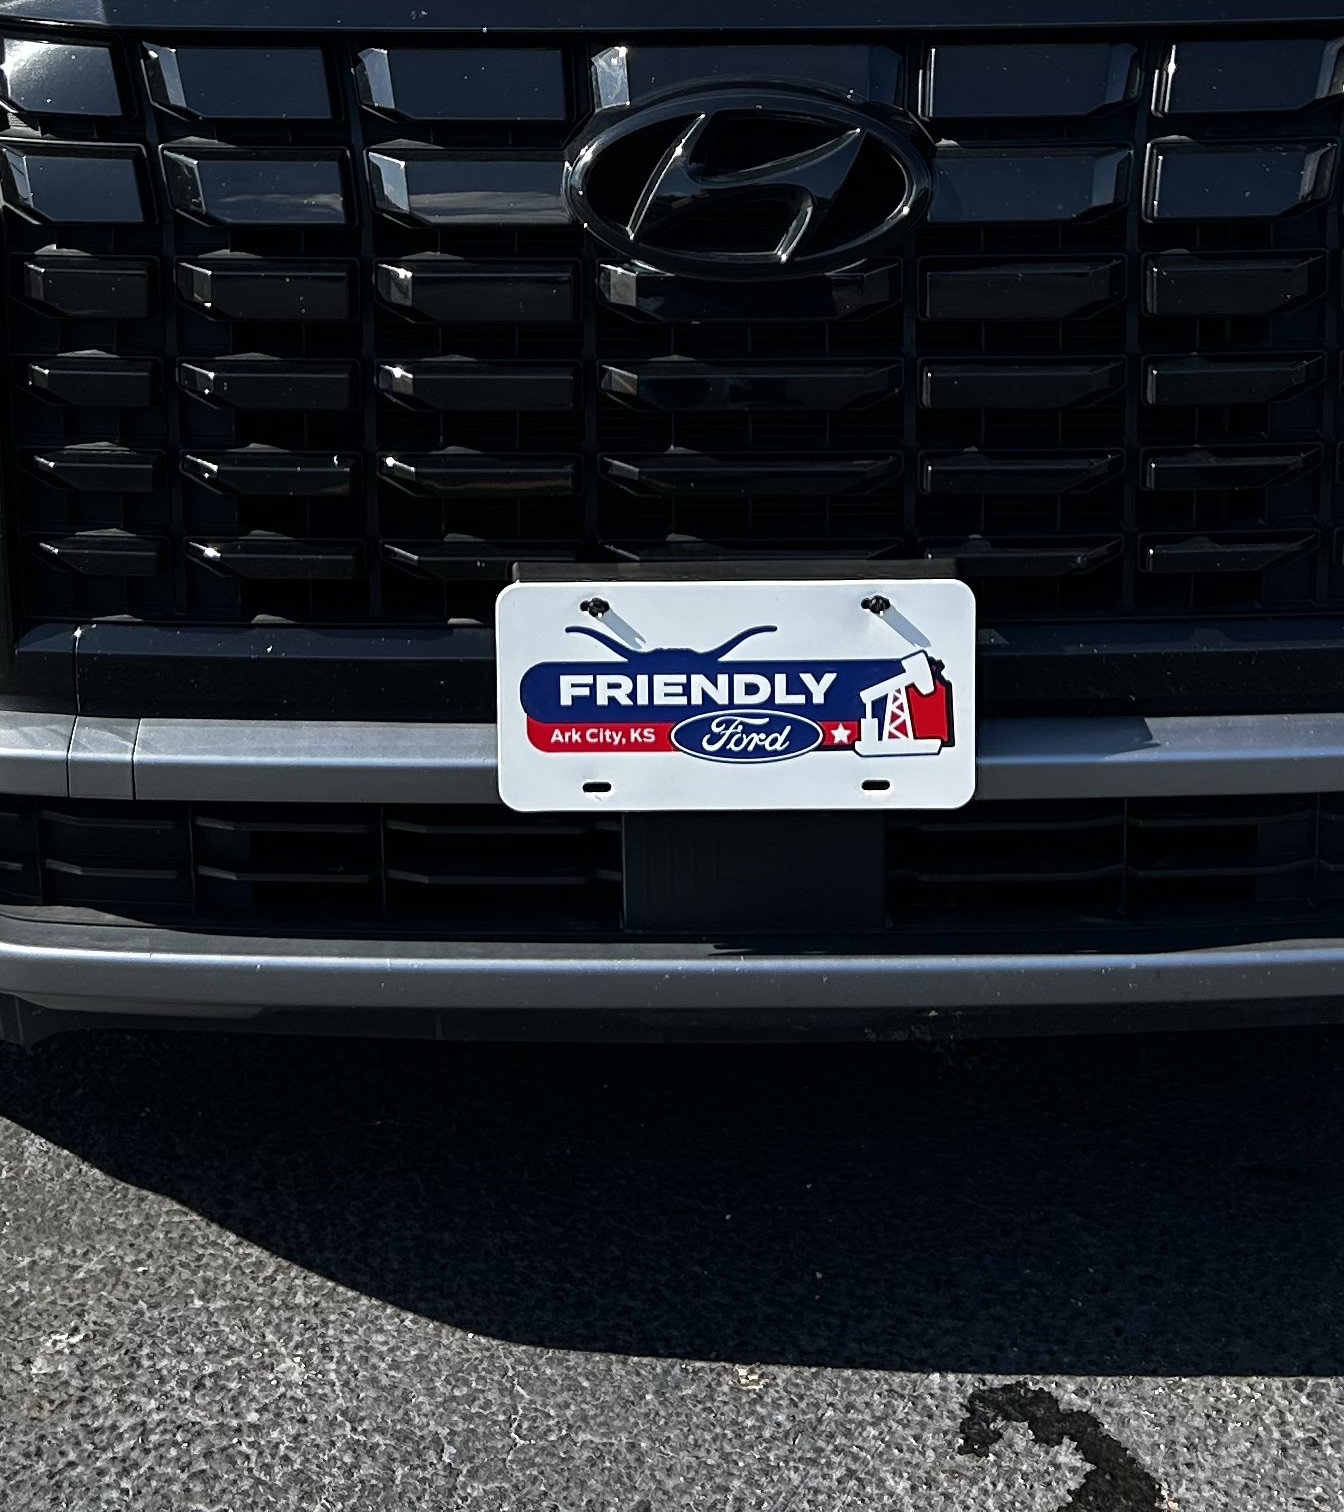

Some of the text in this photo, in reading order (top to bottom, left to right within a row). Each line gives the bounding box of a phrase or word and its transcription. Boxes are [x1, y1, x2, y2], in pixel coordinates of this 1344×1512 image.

[559, 674, 838, 706] FRIENDLY
[550, 727, 656, 747] Ark City, KS
[702, 717, 790, 753] Ford
